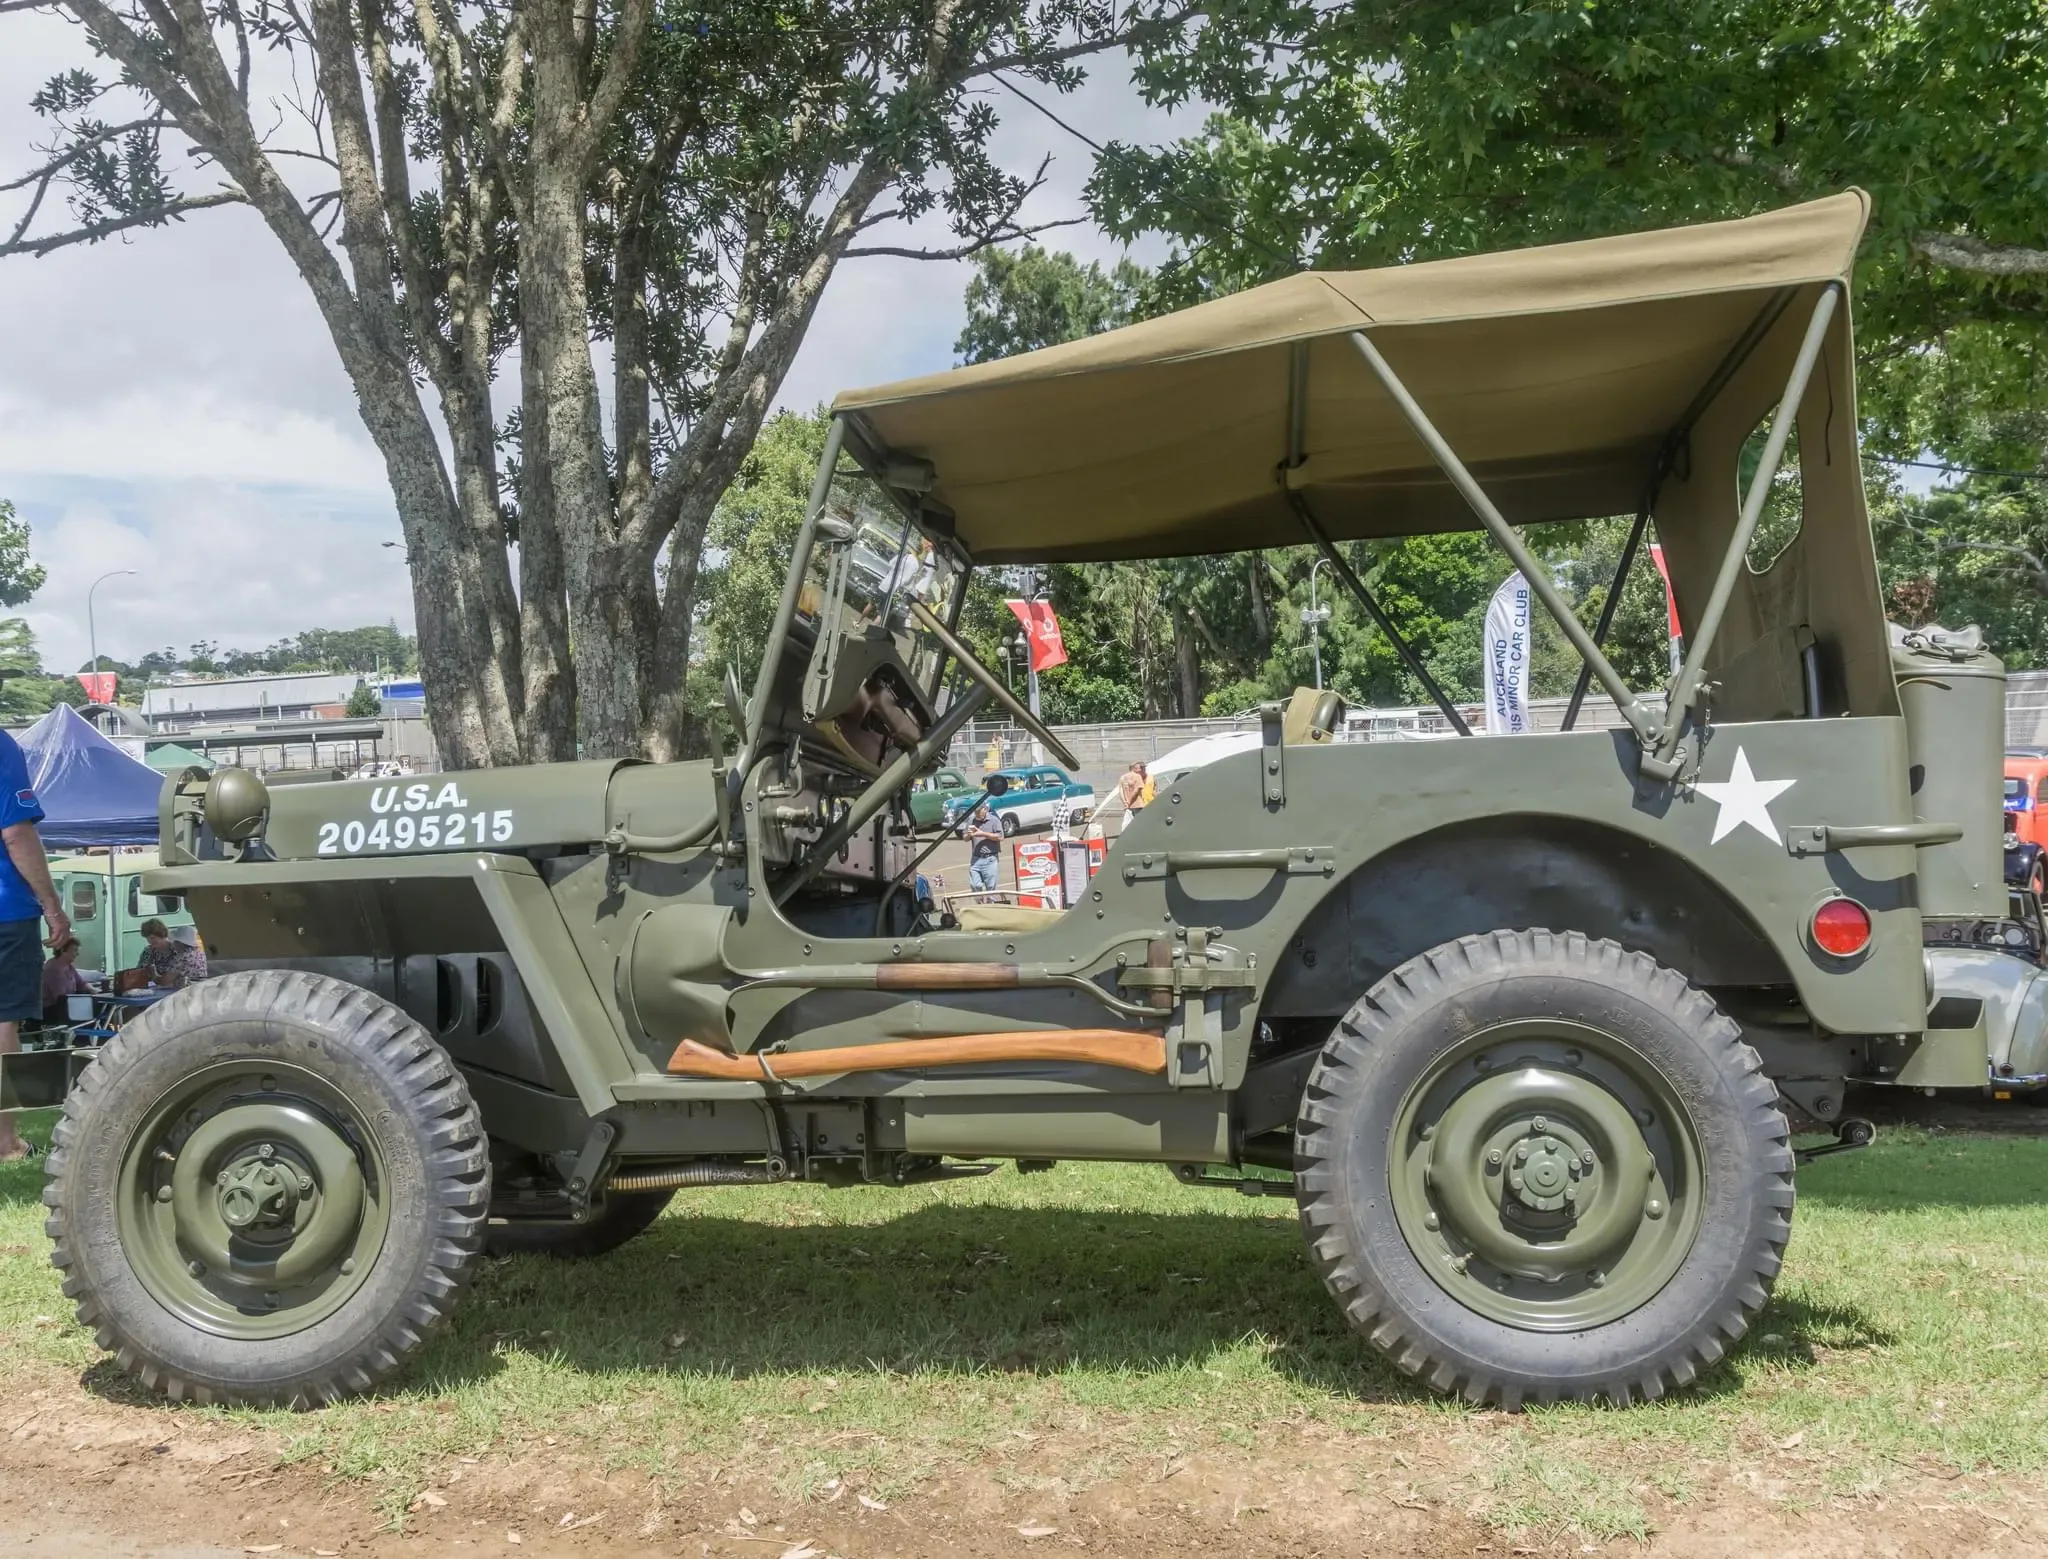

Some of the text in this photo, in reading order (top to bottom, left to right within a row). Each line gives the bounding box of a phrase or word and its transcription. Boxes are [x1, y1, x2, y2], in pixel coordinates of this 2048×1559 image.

[1514, 589, 1528, 628] CLUB
[1511, 631, 1525, 662] CAR
[1496, 639, 1507, 717] AUCKLAND
[1508, 665, 1521, 711] MINOR
[370, 782, 468, 813] U.S.A.
[318, 809, 513, 855] 20495215
